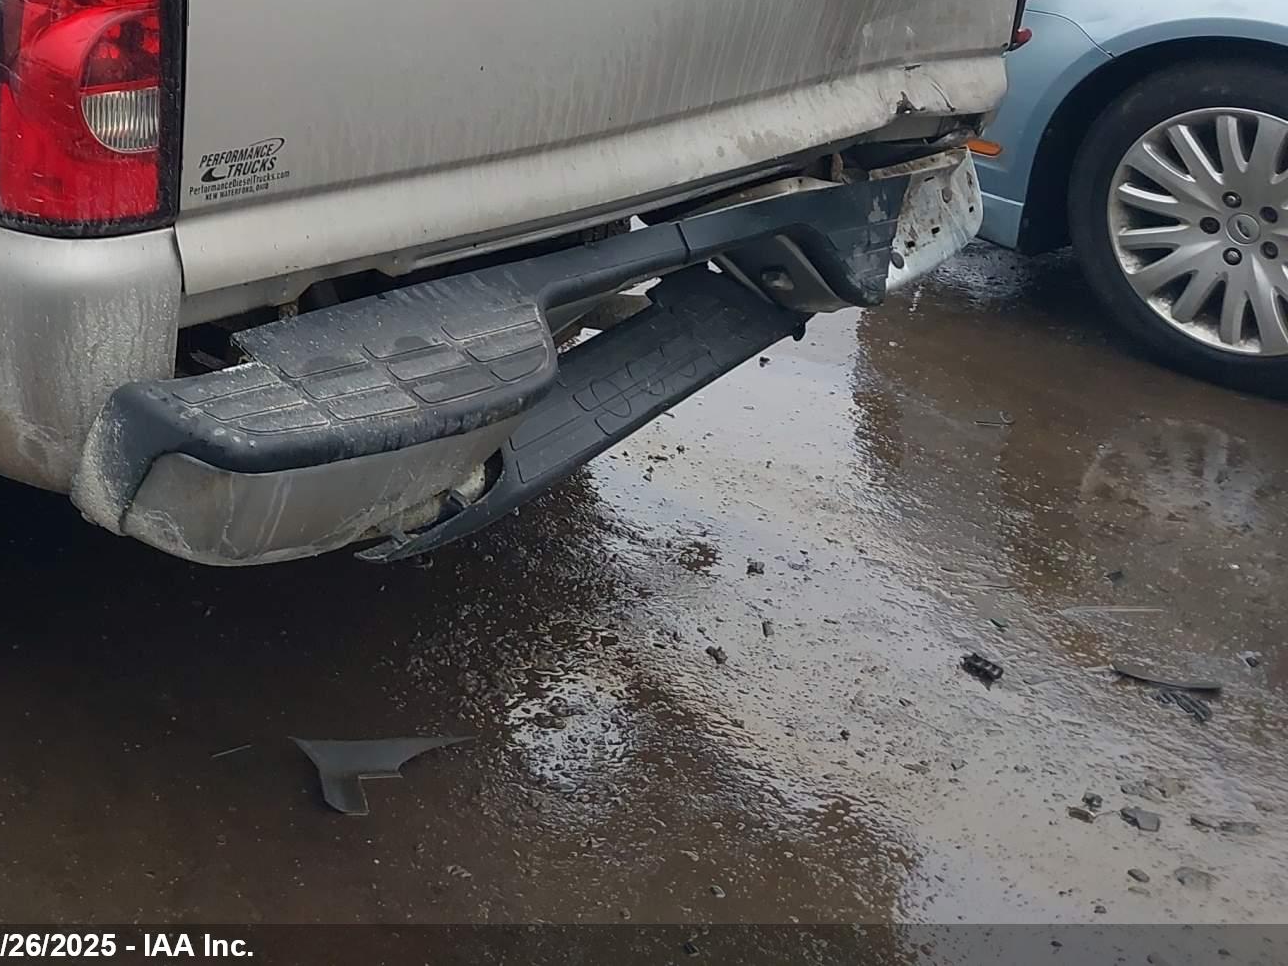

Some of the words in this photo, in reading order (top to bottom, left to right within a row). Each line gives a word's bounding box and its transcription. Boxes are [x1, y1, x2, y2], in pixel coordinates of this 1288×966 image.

[198, 143, 275, 169] PERFORMANCE
[226, 156, 277, 179] TRUCKS
[189, 170, 290, 196] PerformanceDieselTrucks.com
